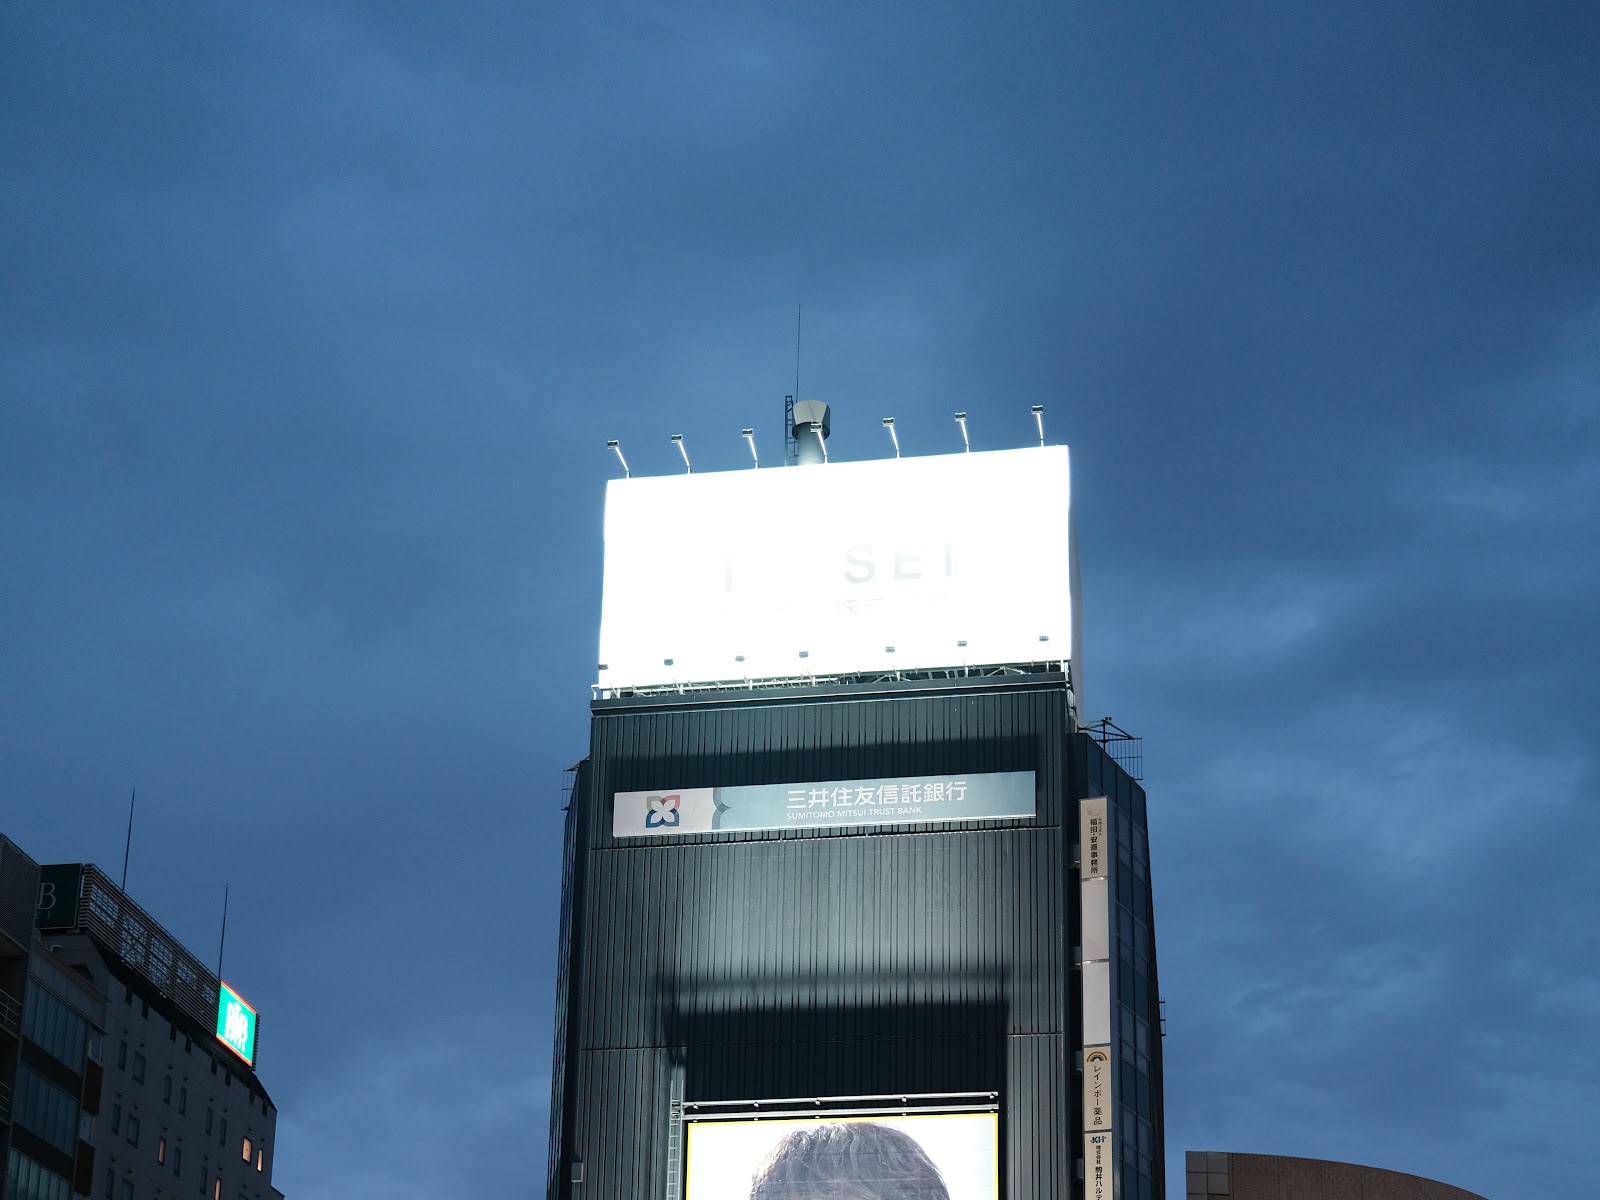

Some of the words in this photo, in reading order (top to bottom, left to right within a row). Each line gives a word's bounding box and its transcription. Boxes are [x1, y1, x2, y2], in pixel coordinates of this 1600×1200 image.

[787, 781, 967, 808] 三井住友信託銀行
[787, 810, 835, 820] SUMITOMO
[837, 809, 866, 817] MITSUI
[869, 807, 895, 816] TRUST
[897, 806, 922, 814] BANK
[1093, 1065, 1102, 1125] レインボー薬品
